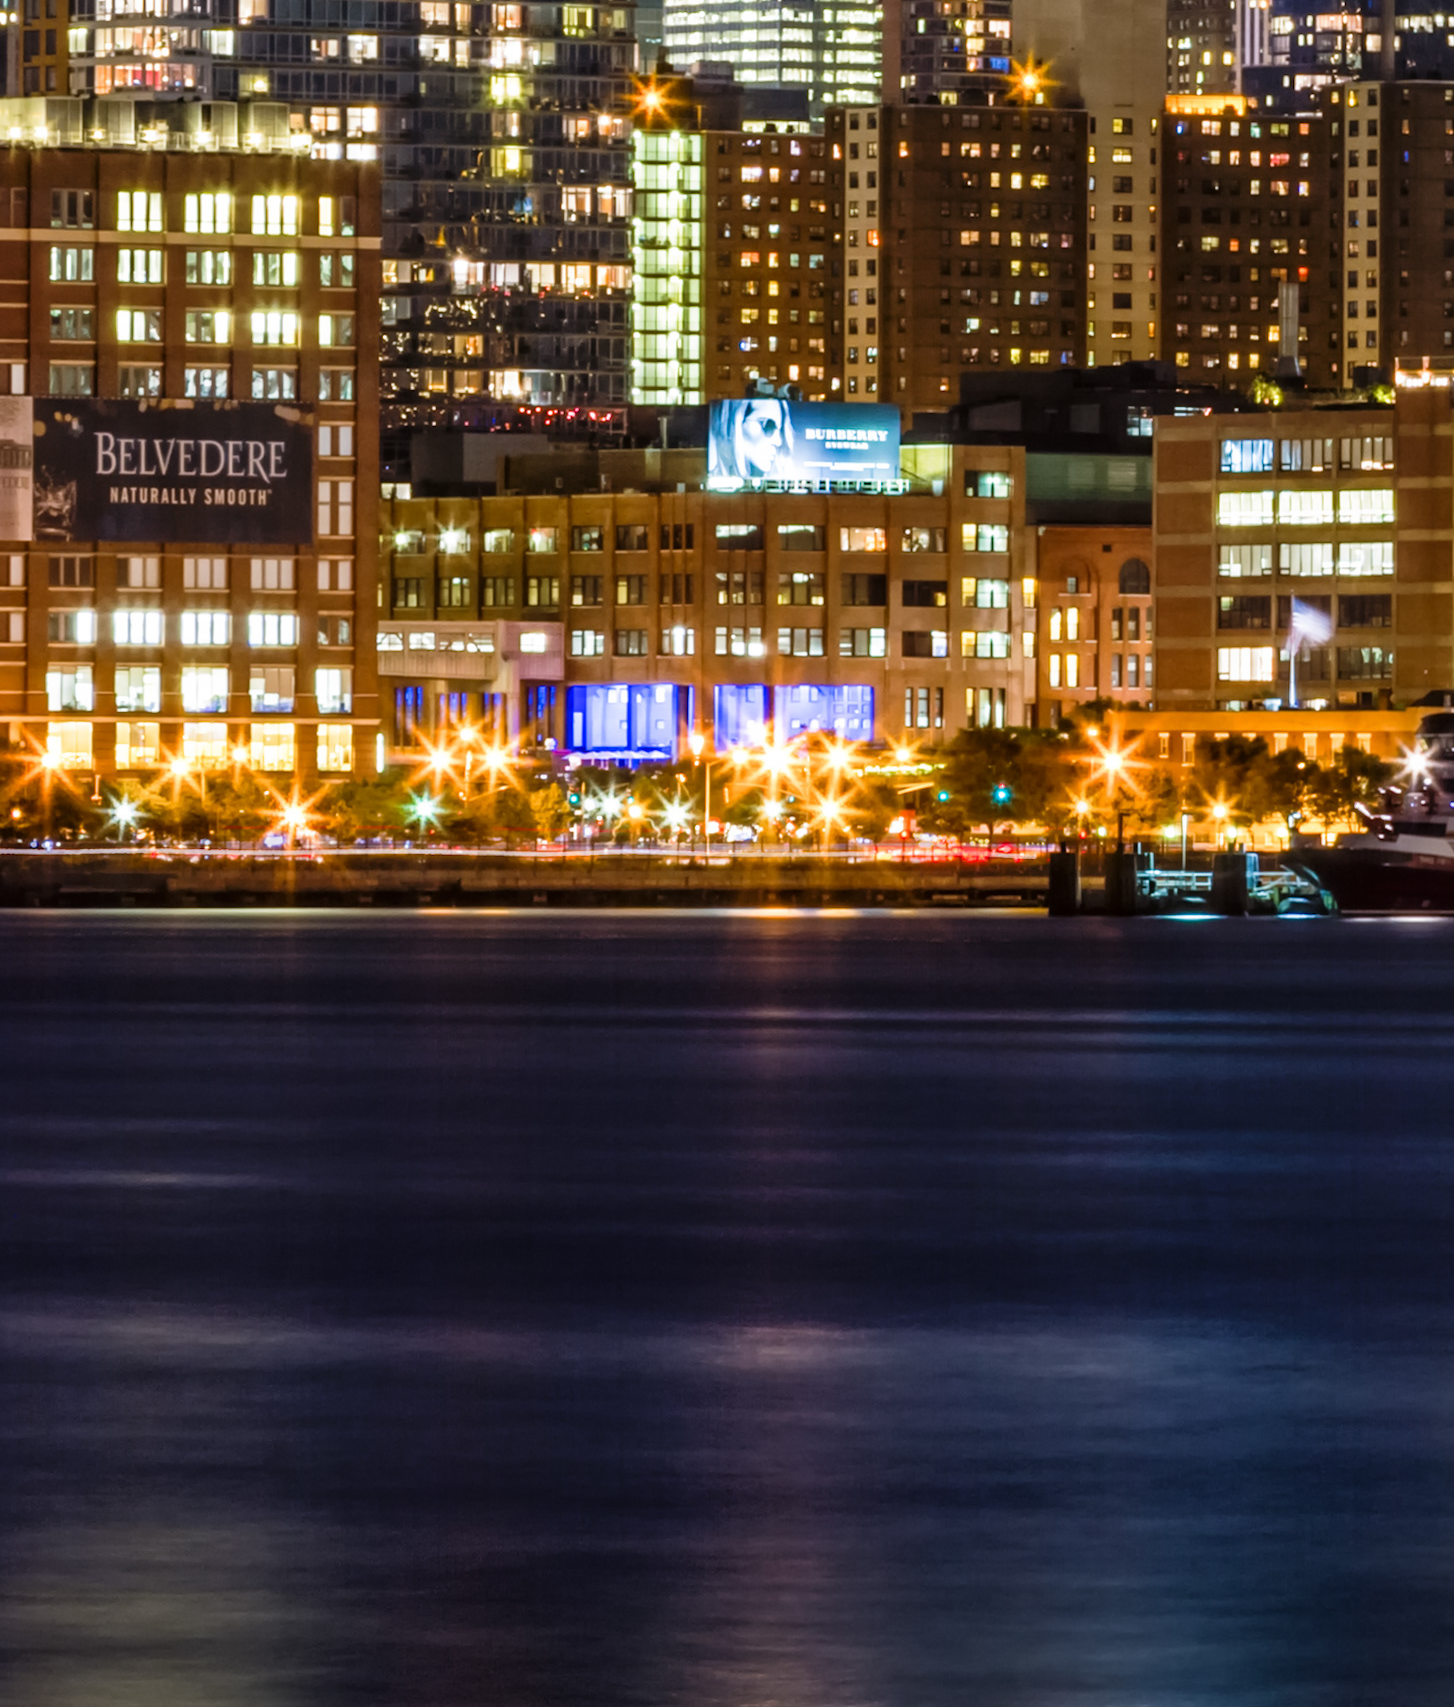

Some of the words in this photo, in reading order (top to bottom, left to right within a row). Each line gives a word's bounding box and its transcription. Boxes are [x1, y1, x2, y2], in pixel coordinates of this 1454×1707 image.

[805, 428, 888, 442] BURBERRY
[94, 432, 287, 484] BELVEDERE
[110, 487, 197, 505] NATURALLY
